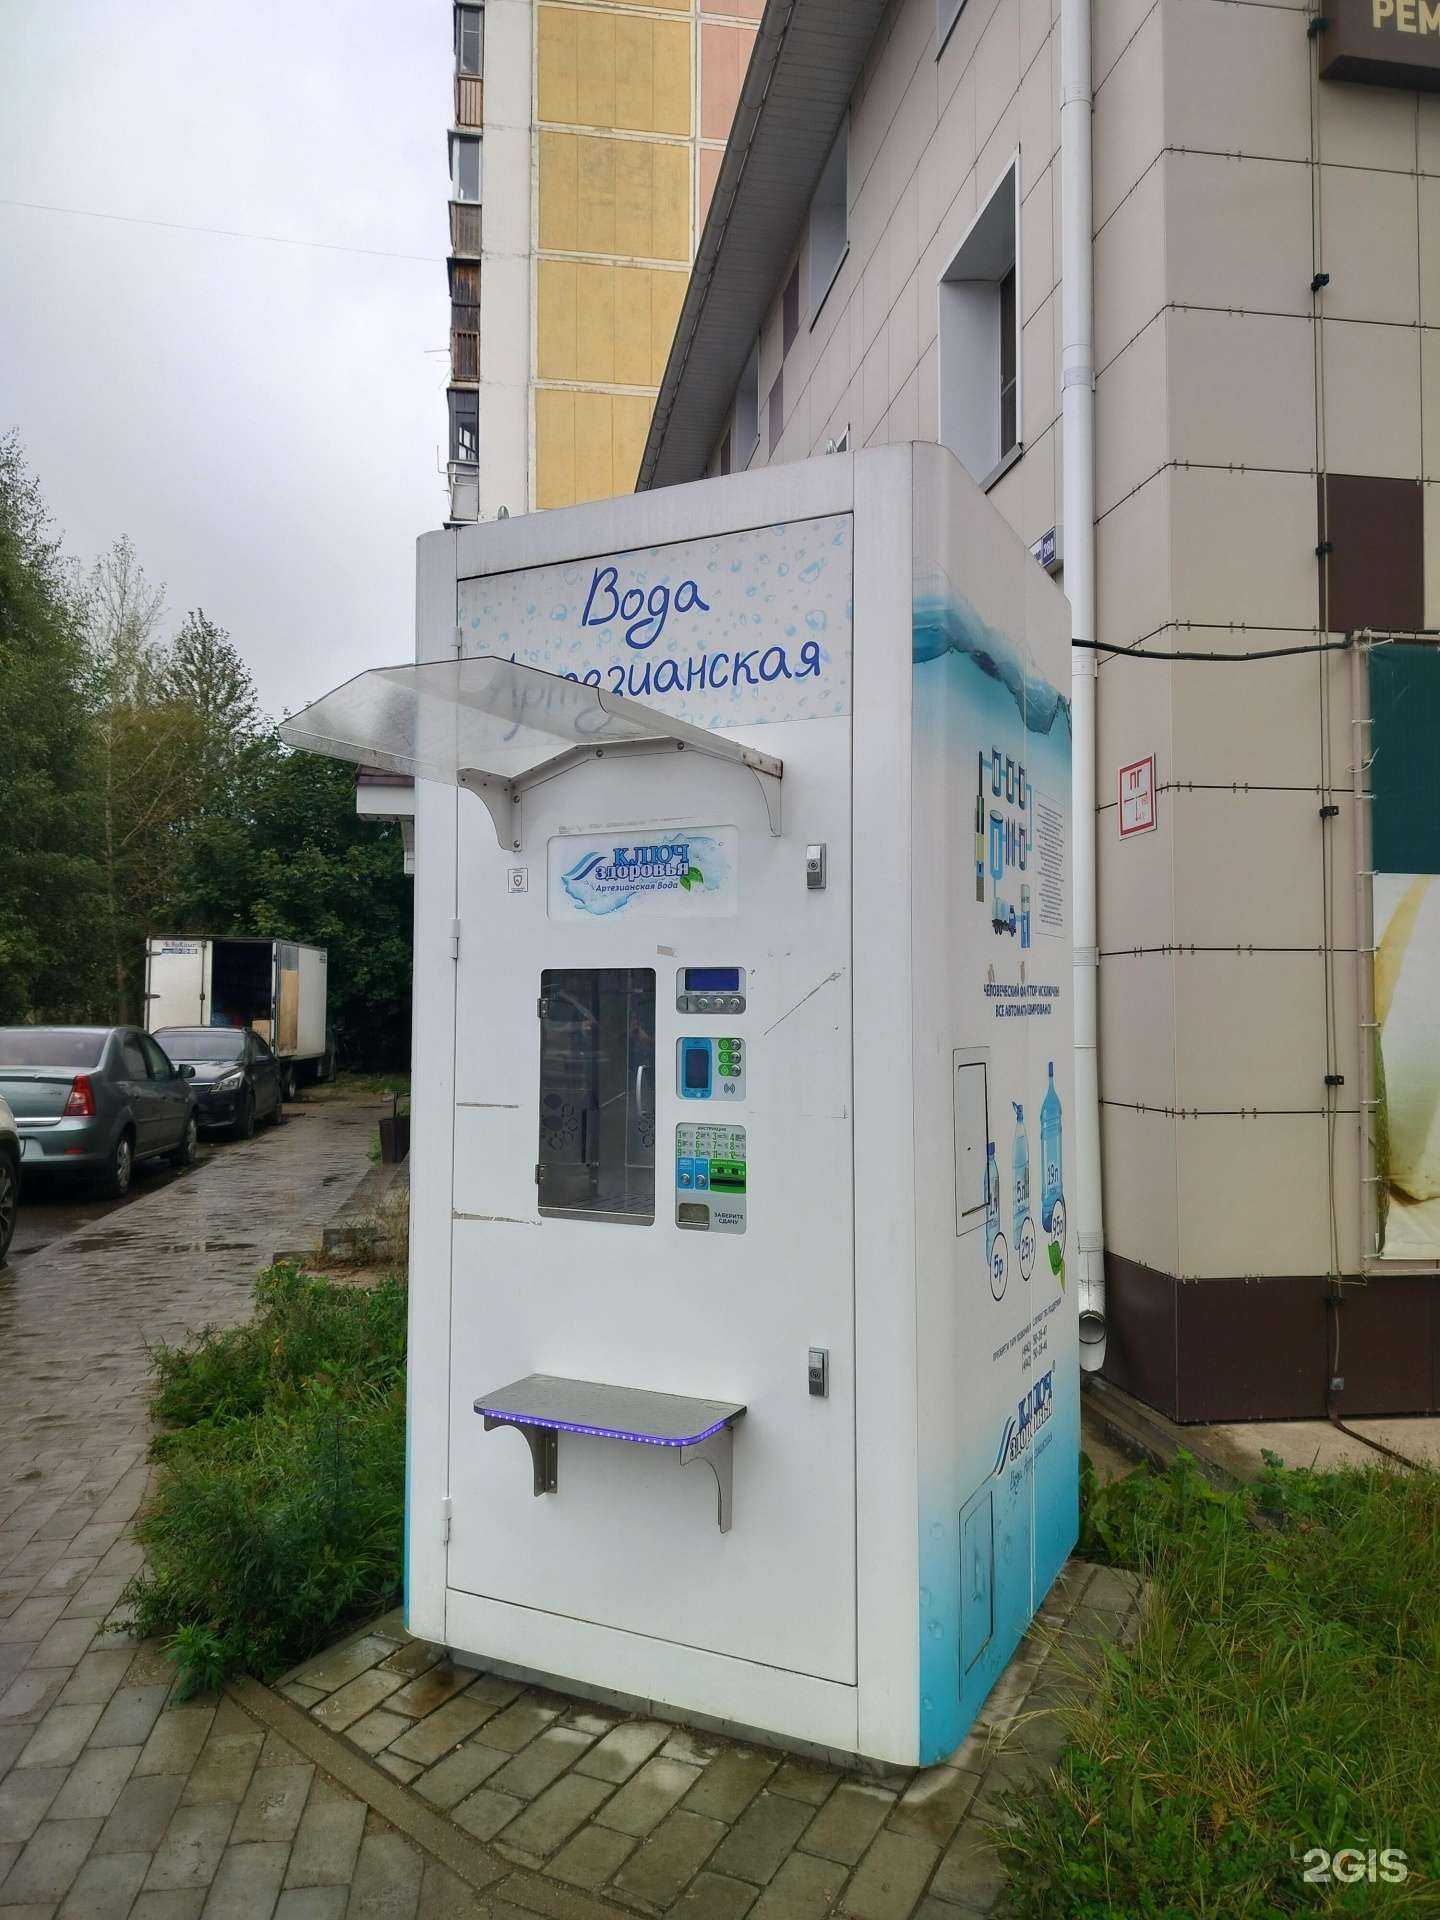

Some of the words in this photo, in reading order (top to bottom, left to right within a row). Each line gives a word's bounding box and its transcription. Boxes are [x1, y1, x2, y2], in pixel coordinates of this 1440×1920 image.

[582, 567, 710, 649] Вода
[613, 844, 689, 867] КЛЮЧ
[596, 882, 655, 893] Артезианская
[714, 1211, 744, 1220] ЗАБЕРИТЕ
